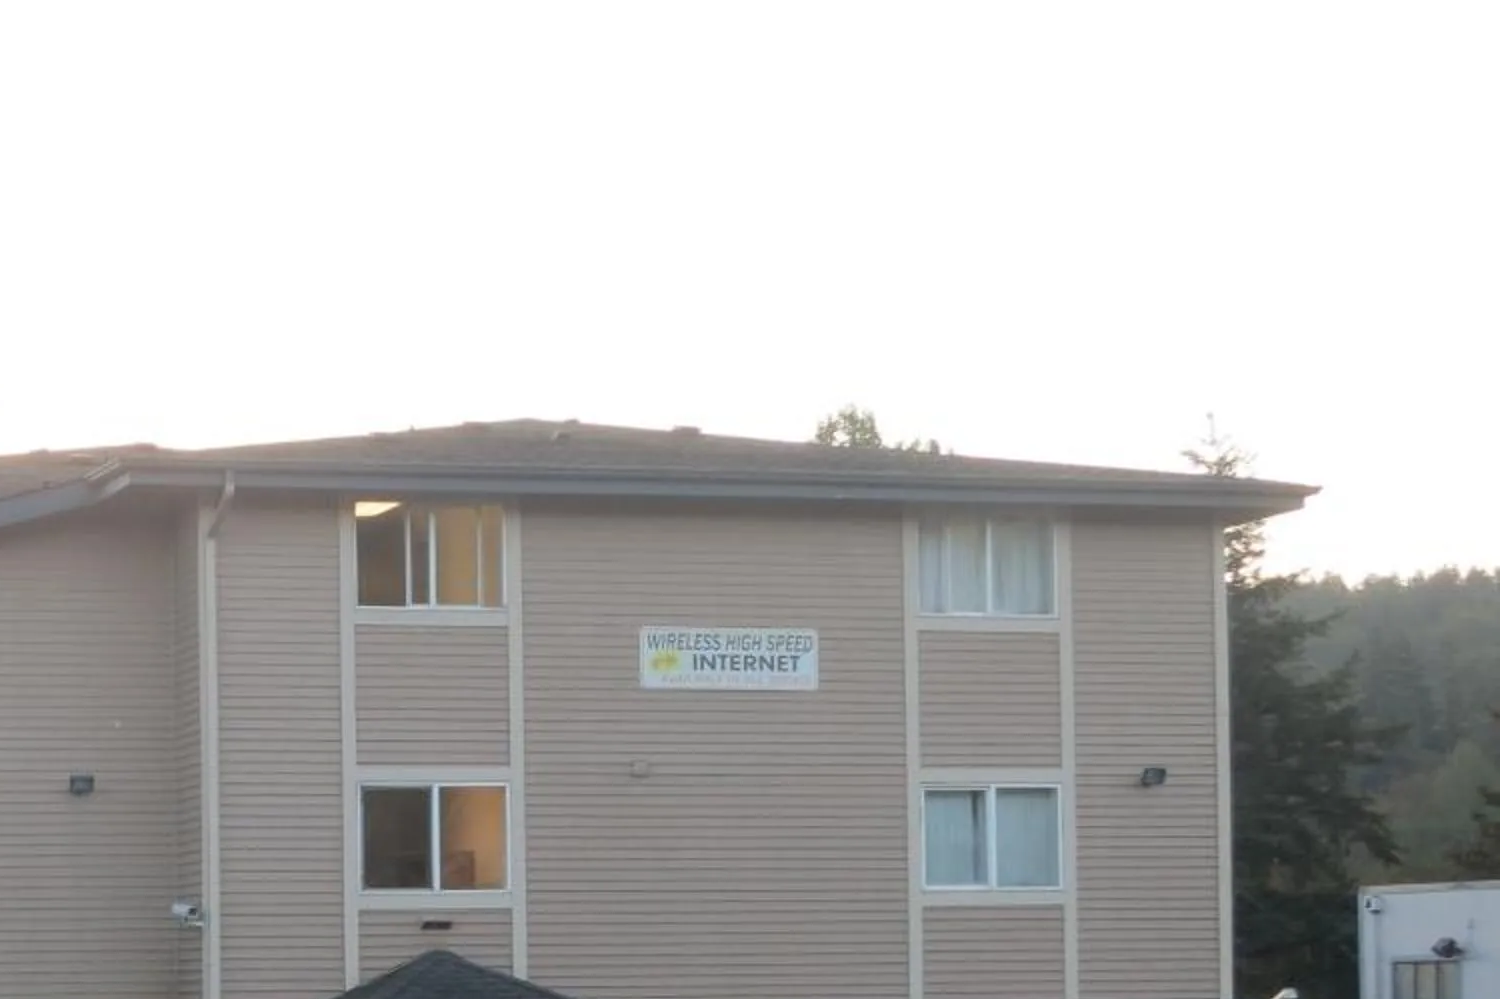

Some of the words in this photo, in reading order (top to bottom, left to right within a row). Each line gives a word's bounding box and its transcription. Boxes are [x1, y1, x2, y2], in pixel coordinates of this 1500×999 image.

[647, 633, 721, 651] WIRELESS
[725, 634, 762, 651] HIGH
[766, 635, 813, 653] SPEED
[693, 653, 801, 672] INTERNET
